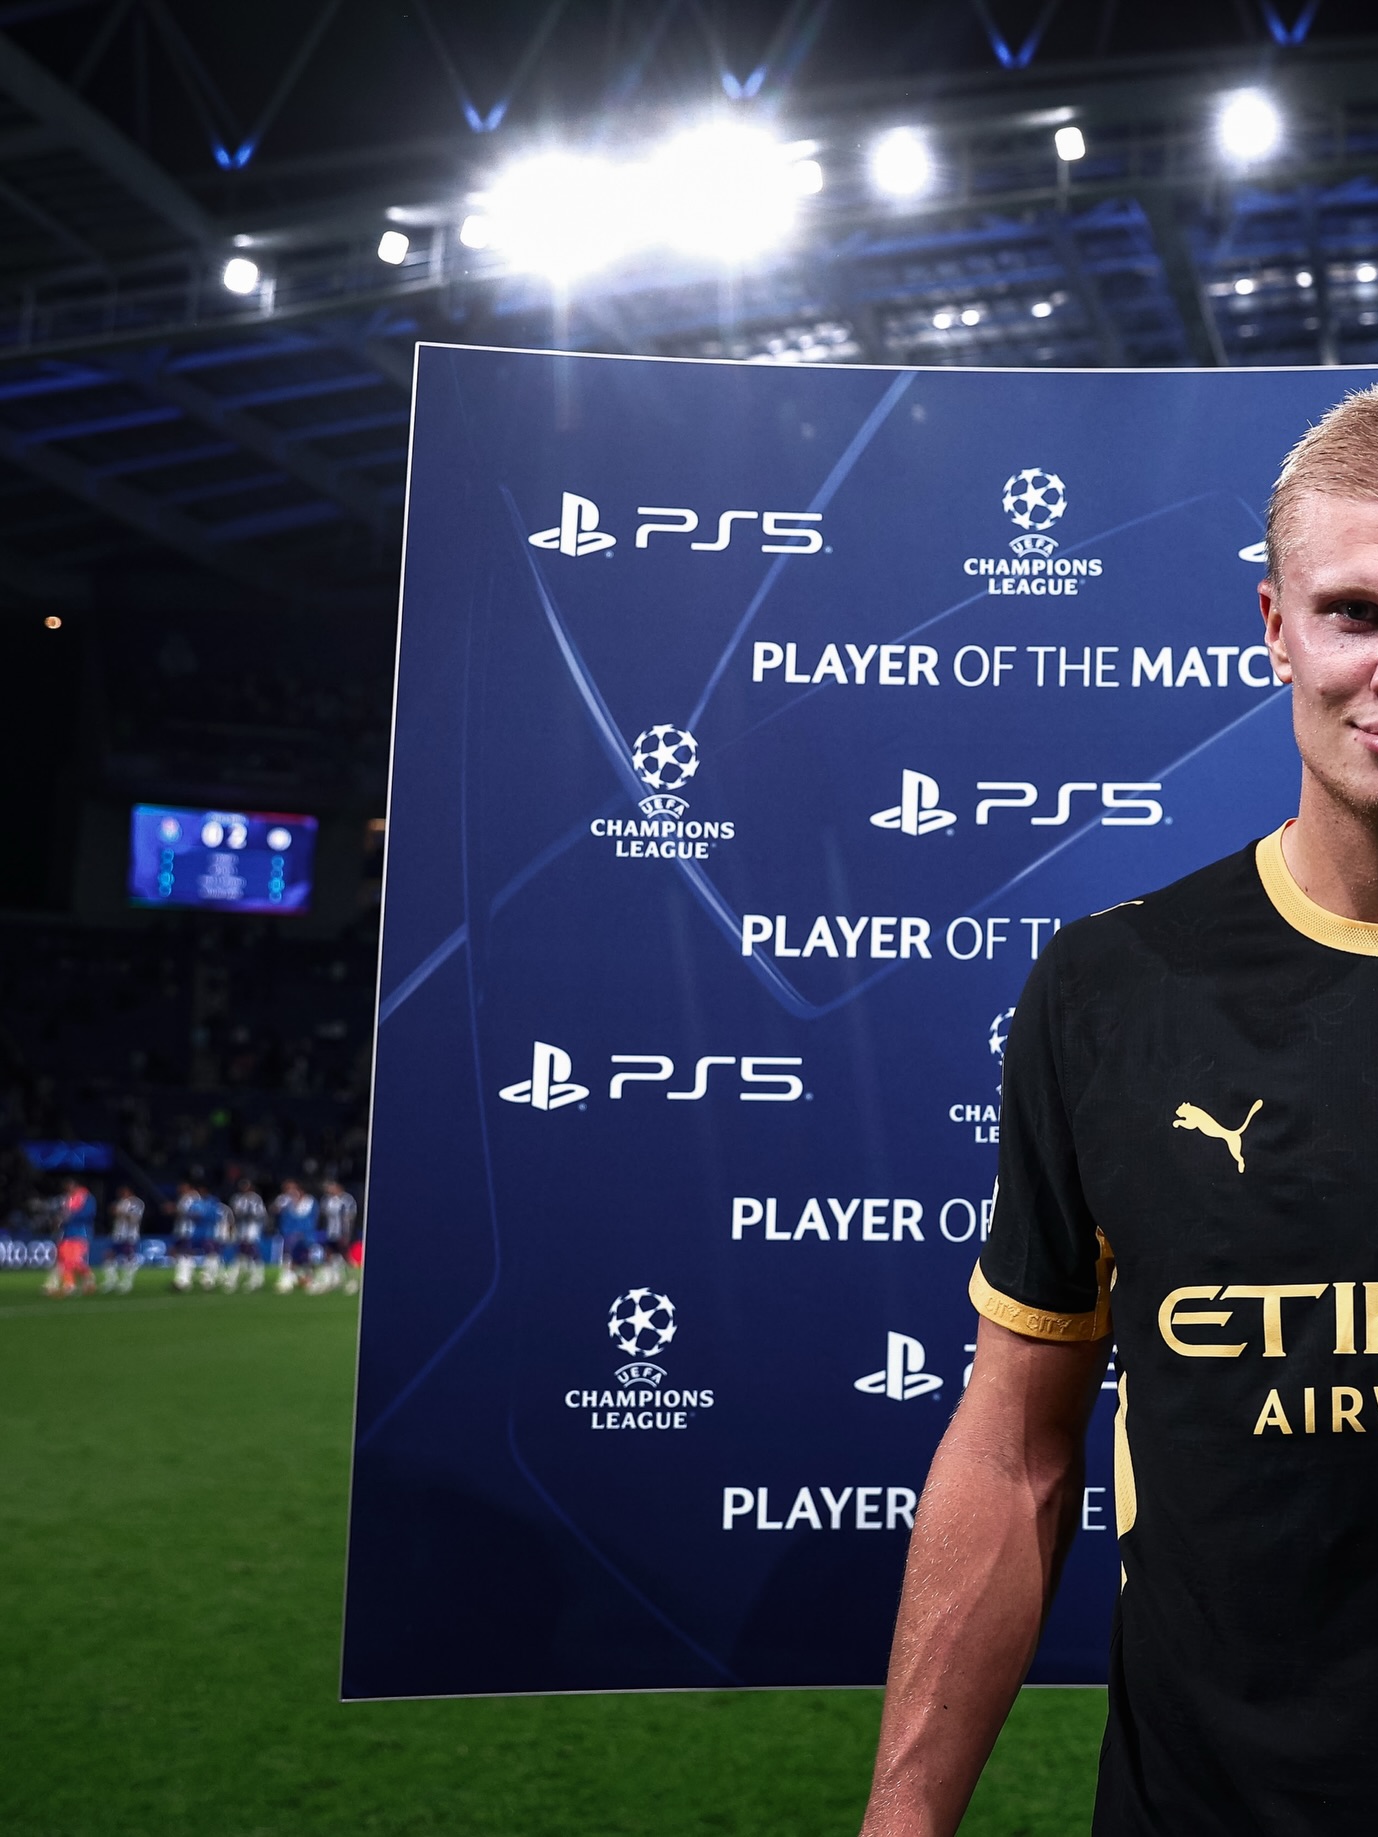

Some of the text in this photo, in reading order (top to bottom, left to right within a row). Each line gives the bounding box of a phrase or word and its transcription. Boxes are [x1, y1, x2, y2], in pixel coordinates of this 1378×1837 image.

[635, 506, 823, 554] PS5
[1011, 537, 1055, 555] UEFA
[963, 557, 1103, 577] CHAMPIONS
[988, 577, 1078, 596] LEAGUE
[752, 641, 1280, 688] PLAYER OF THE MATC
[640, 798, 685, 816] UEFA
[975, 781, 1163, 826] PS5
[590, 818, 735, 840] CHAMPIONS
[615, 840, 709, 860] LEAGUE
[741, 914, 932, 959] PLAYER
[946, 916, 1011, 960] OF
[609, 1054, 804, 1102] PS5
[731, 1197, 925, 1242] PLAYER
[1026, 1312, 1073, 1334] CITY
[617, 1366, 662, 1384] UEFA
[564, 1389, 715, 1408] CHAMPIONS
[591, 1411, 688, 1430] LEAGUE
[722, 1486, 915, 1530] PLAYER
